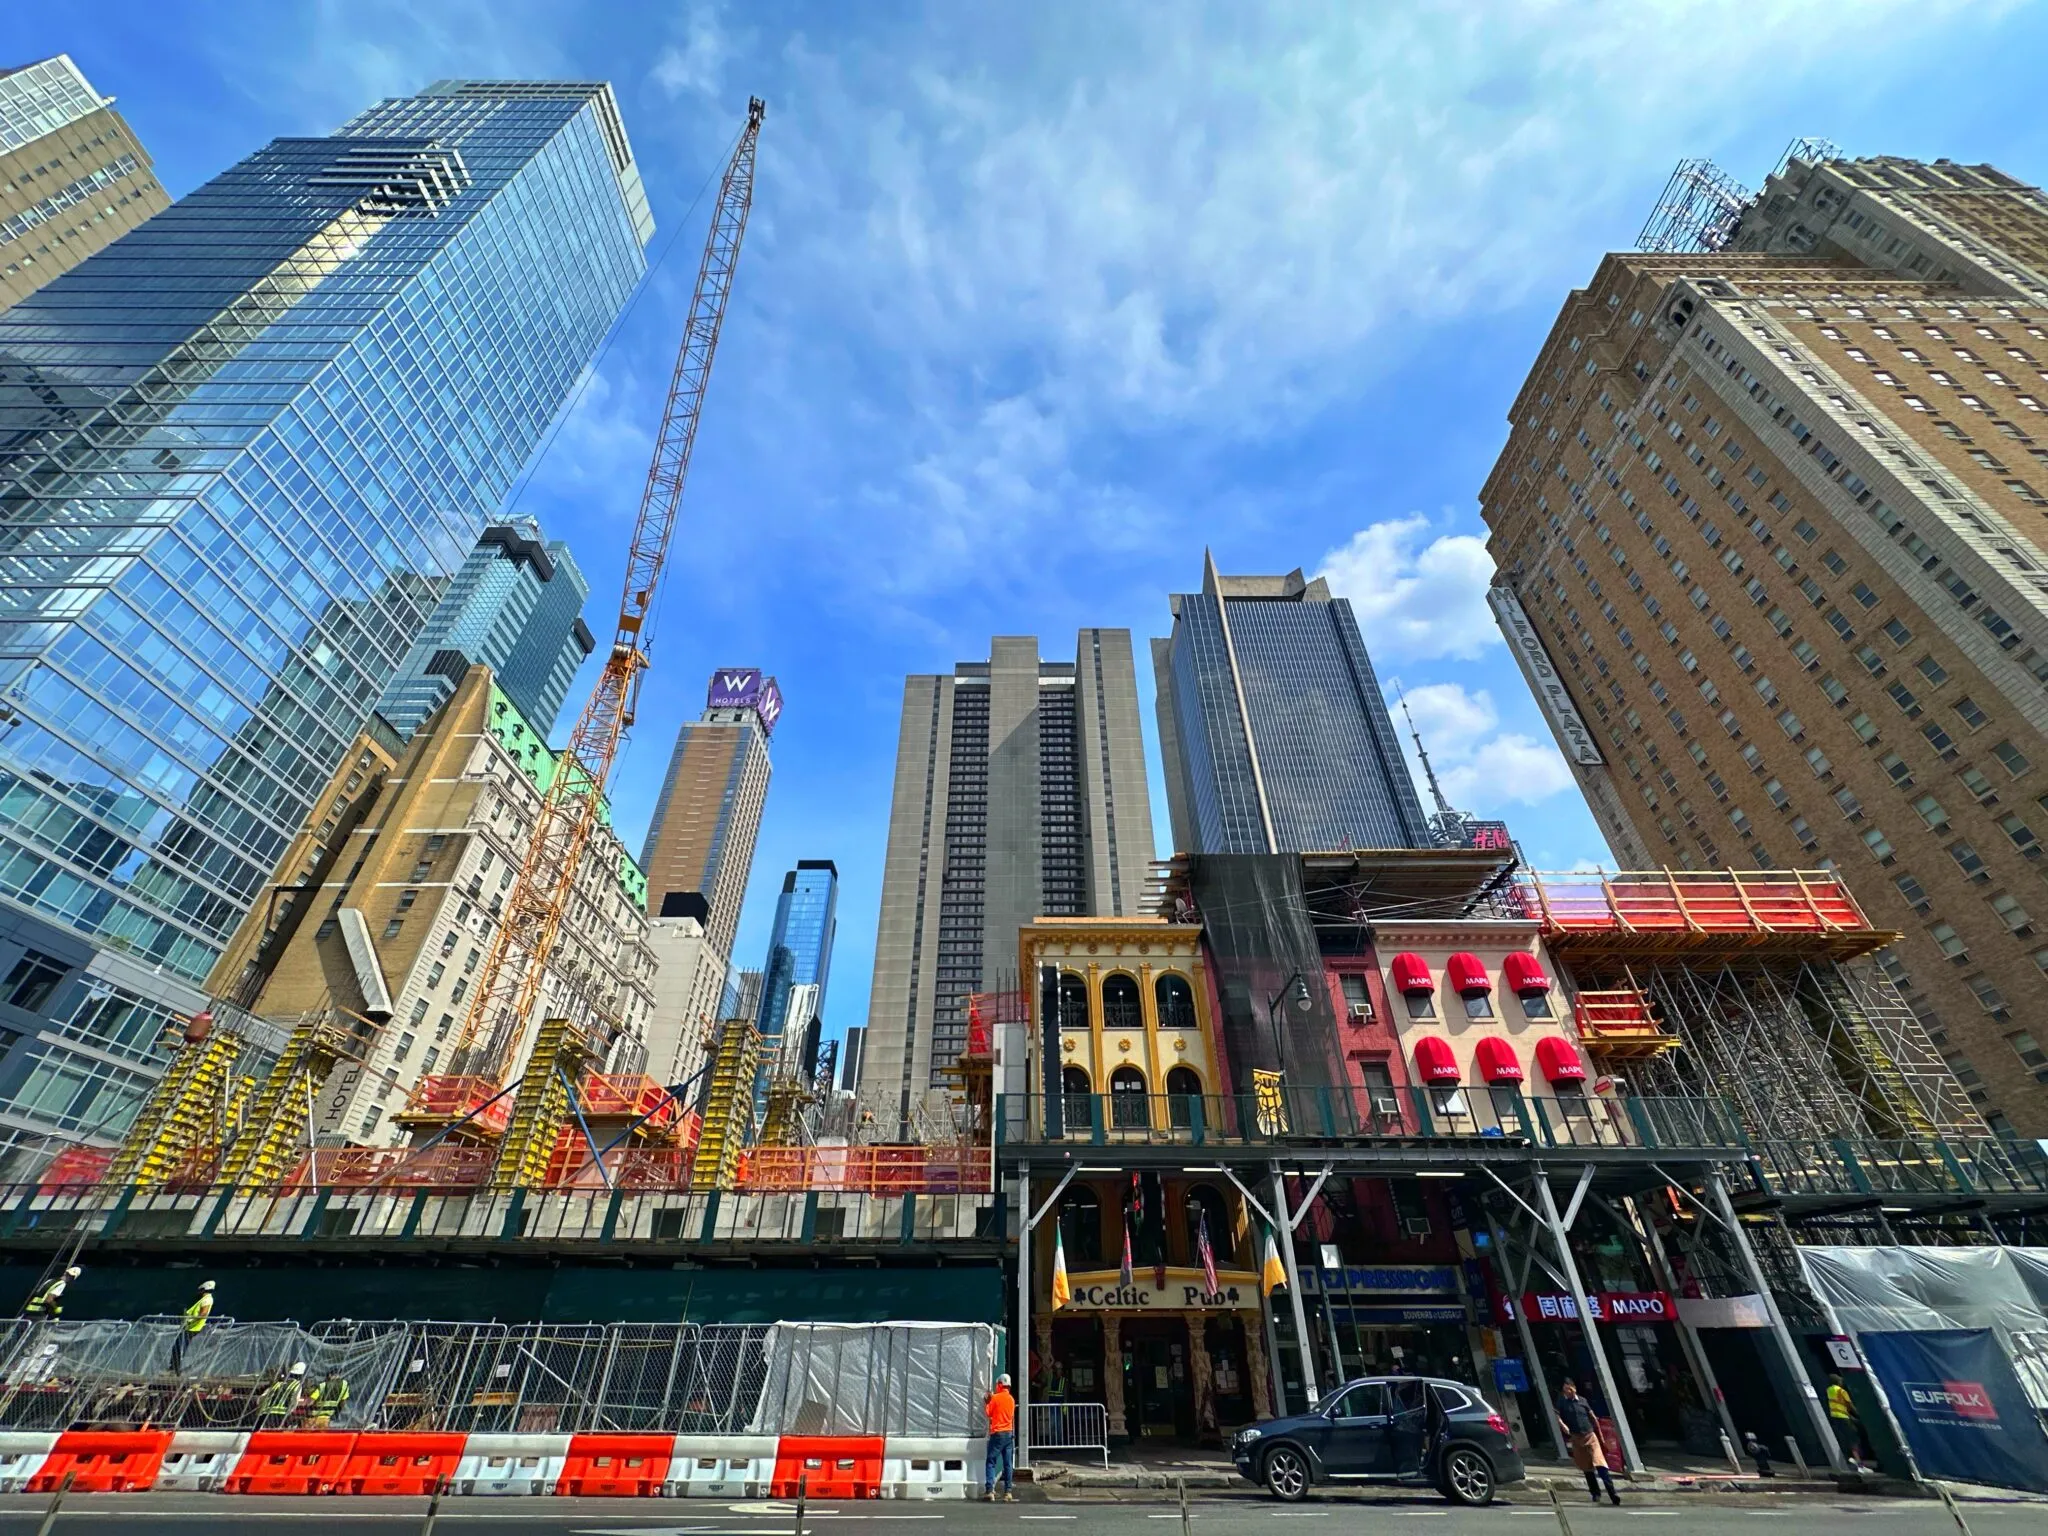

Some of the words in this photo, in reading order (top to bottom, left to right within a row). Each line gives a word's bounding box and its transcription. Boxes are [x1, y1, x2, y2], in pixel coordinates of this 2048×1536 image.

[724, 675, 752, 692] W
[1492, 588, 1553, 678] MILFORD
[1545, 684, 1600, 762] PLAZA
[325, 1064, 361, 1120] HOTEL
[1088, 1286, 1150, 1306] Celtic
[1183, 1286, 1227, 1306] Pub
[1612, 1298, 1665, 1315] MAPO
[1838, 1348, 1848, 1361] C
[1912, 1390, 1984, 1407] SUFFOLK
